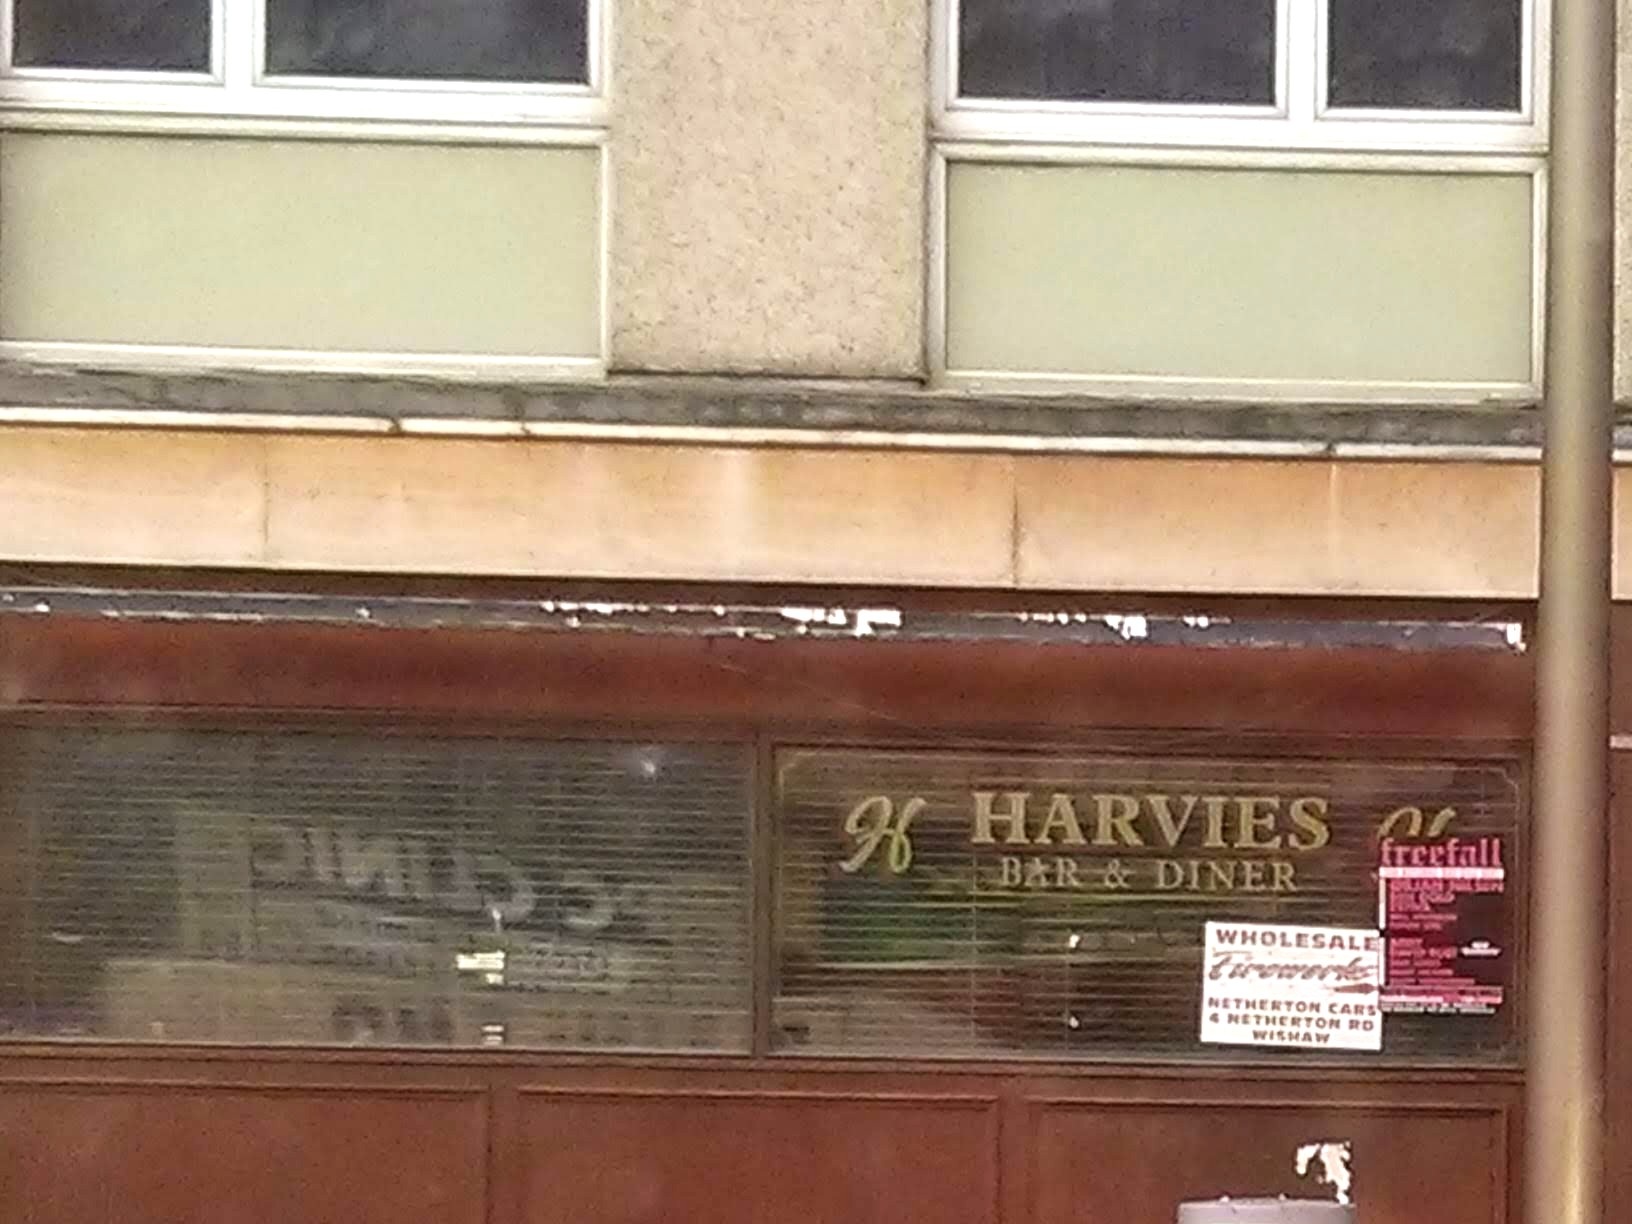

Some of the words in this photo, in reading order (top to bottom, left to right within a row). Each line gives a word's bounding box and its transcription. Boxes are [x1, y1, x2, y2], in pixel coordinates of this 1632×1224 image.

[971, 791, 1331, 850] HARVIES
[1381, 837, 1502, 866] freefall
[1001, 856, 1082, 888] BAR
[1103, 858, 1134, 890] &
[1155, 859, 1297, 893] DINER
[1216, 928, 1379, 951] WHOLESALE
[1207, 996, 1321, 1014] NETHERTON
[1328, 1002, 1377, 1017] CARS
[1226, 1013, 1341, 1030] NETHERTON
[1348, 1019, 1375, 1031] RD
[1252, 1029, 1331, 1044] WISHAW
